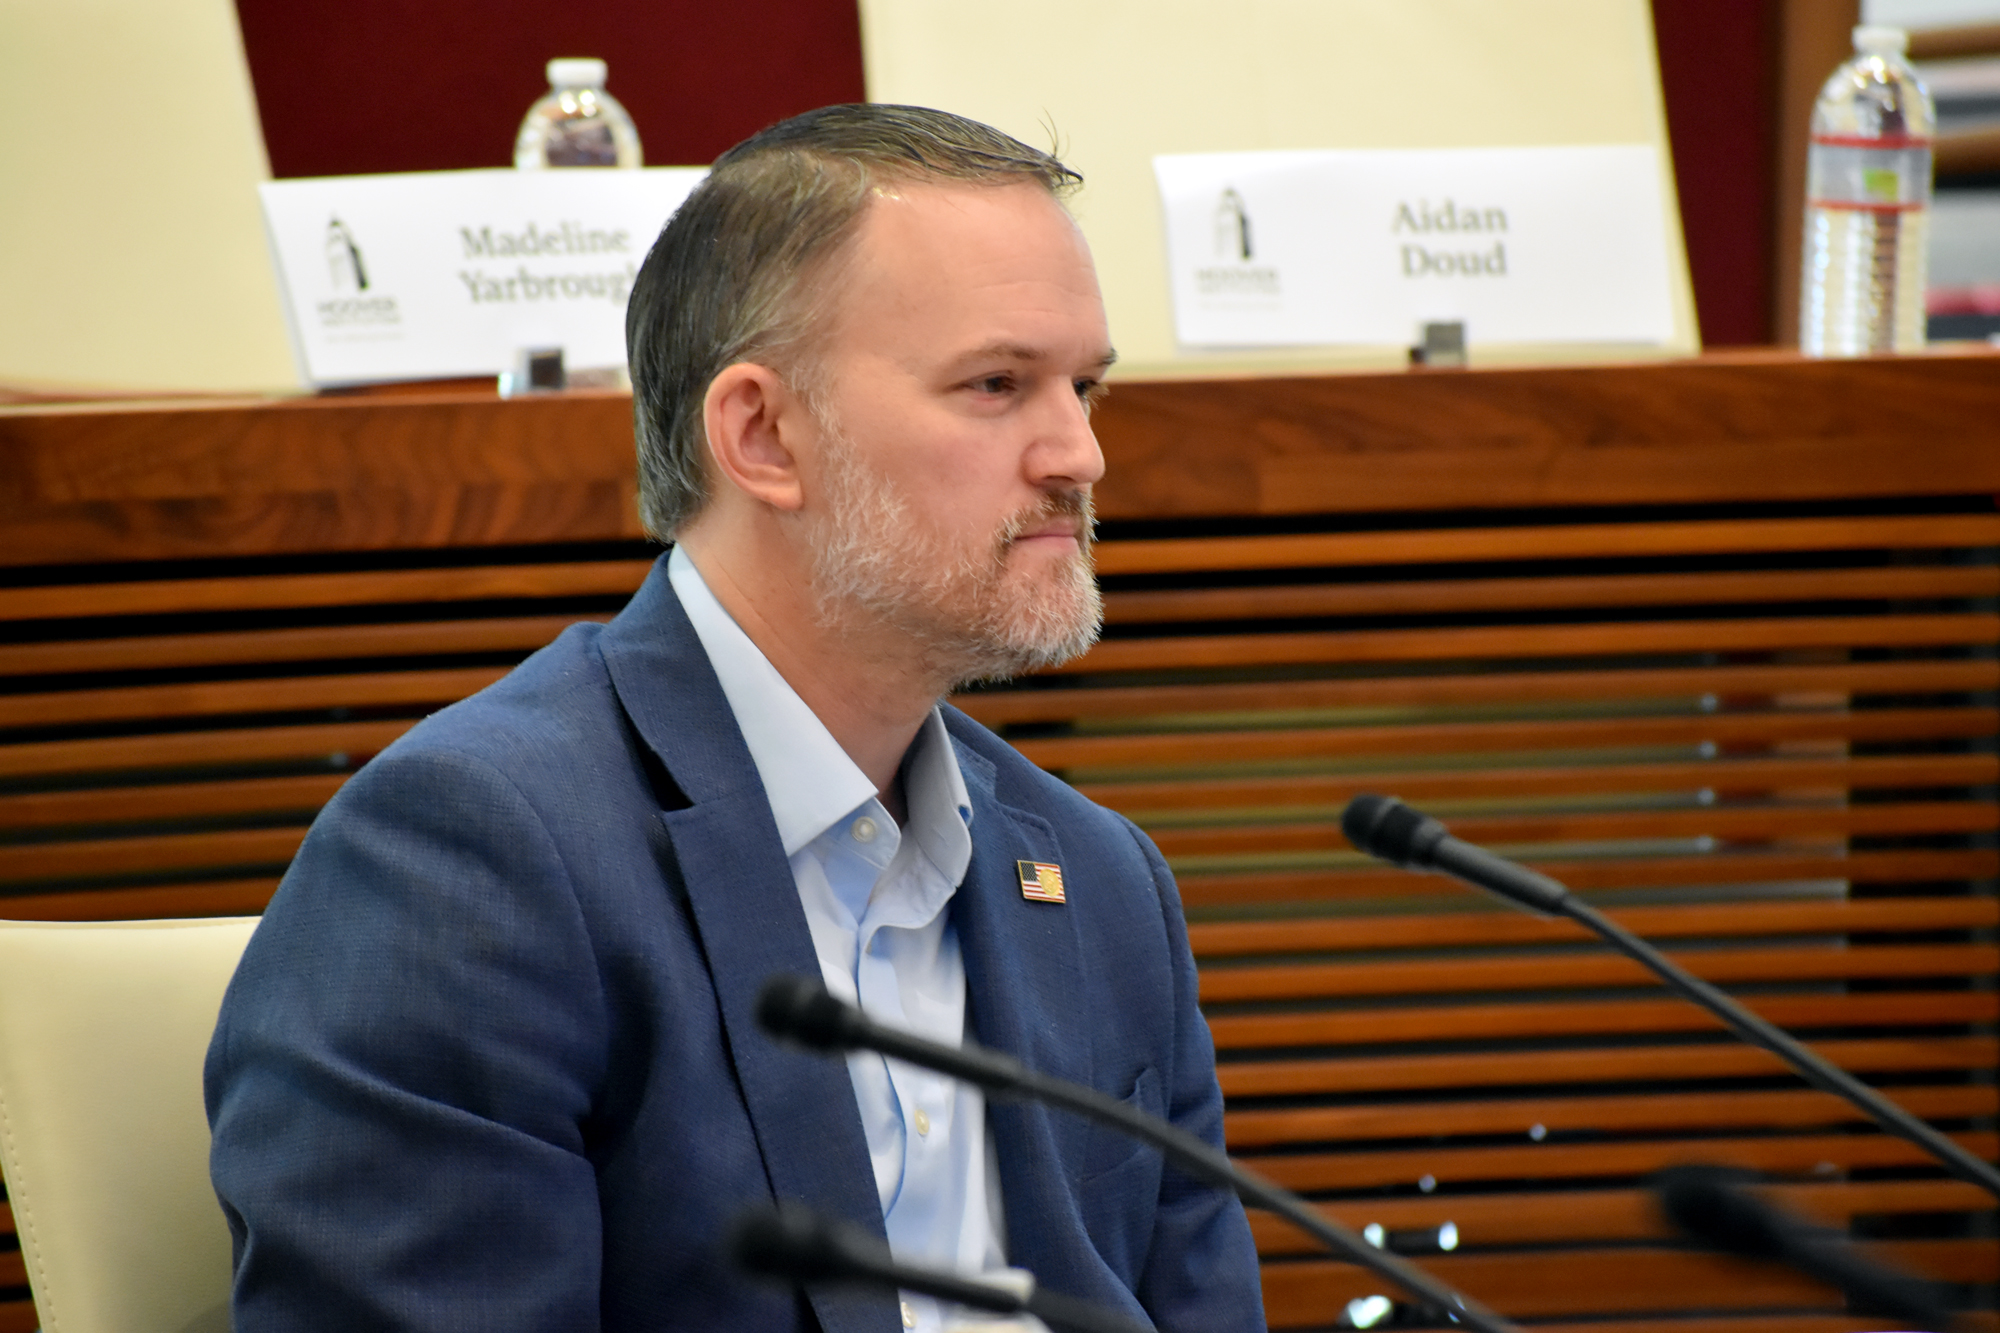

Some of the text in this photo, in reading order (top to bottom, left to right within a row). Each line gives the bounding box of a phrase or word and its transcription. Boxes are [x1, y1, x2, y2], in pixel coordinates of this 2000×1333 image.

[1391, 198, 1508, 233] Aidan
[459, 221, 631, 258] Madeline
[1401, 240, 1508, 277] Doud
